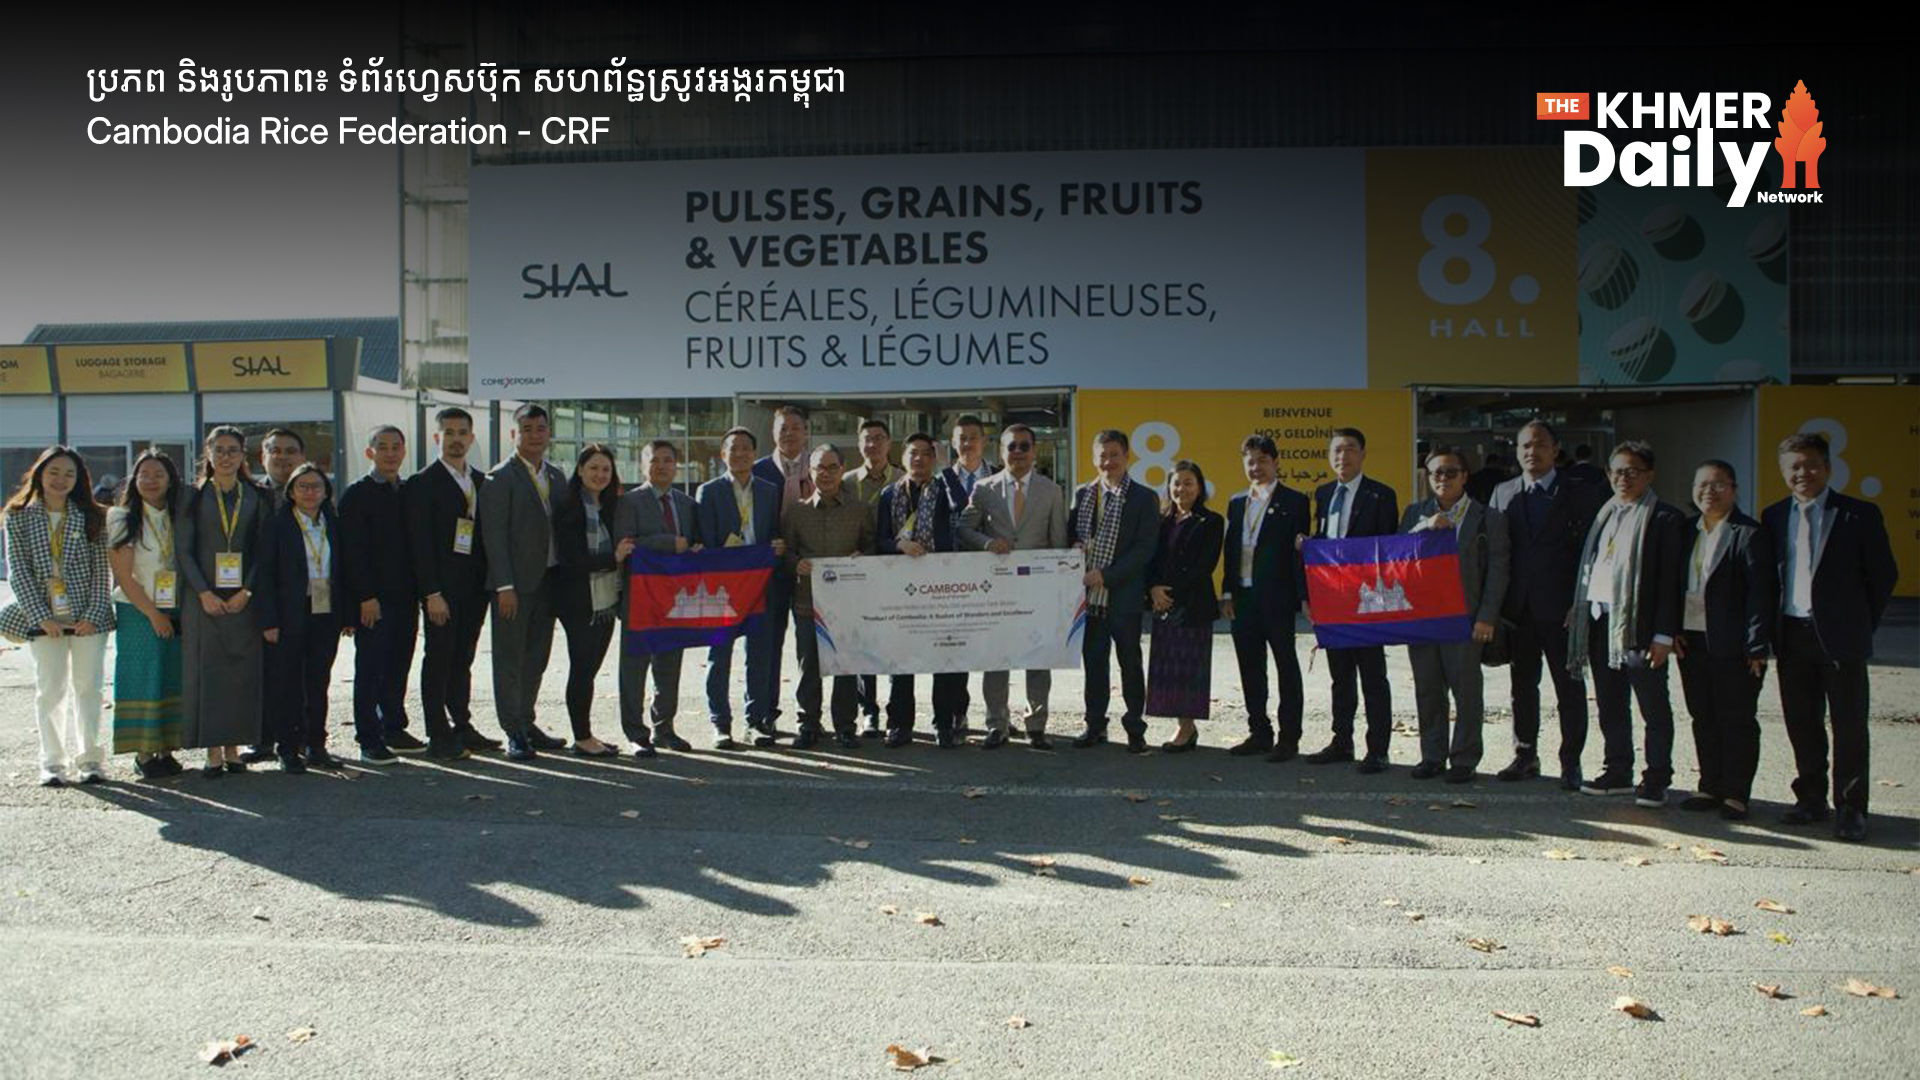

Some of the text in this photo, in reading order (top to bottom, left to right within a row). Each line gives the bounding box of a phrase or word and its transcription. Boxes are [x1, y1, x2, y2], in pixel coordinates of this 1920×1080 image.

[685, 181, 1203, 226] PULSES, GRAINS, FRUITS
[685, 231, 989, 270] & VEGETABLES
[1416, 193, 1541, 305] 8.
[521, 262, 629, 299] SIAL
[685, 278, 1217, 326] CÉRÉALES, LÉGUMINEUSES,
[1429, 317, 1537, 339] HALL
[685, 325, 1050, 369] FRUITS & LÉGUMES
[0, 360, 19, 370] OM
[75, 356, 167, 368] LUGGAGE STORAGE
[232, 355, 291, 377] SIAL
[1263, 407, 1333, 419] BIENVENUE
[1284, 426, 1334, 438] GELDİNİ
[919, 583, 978, 595] CAMBODIA
